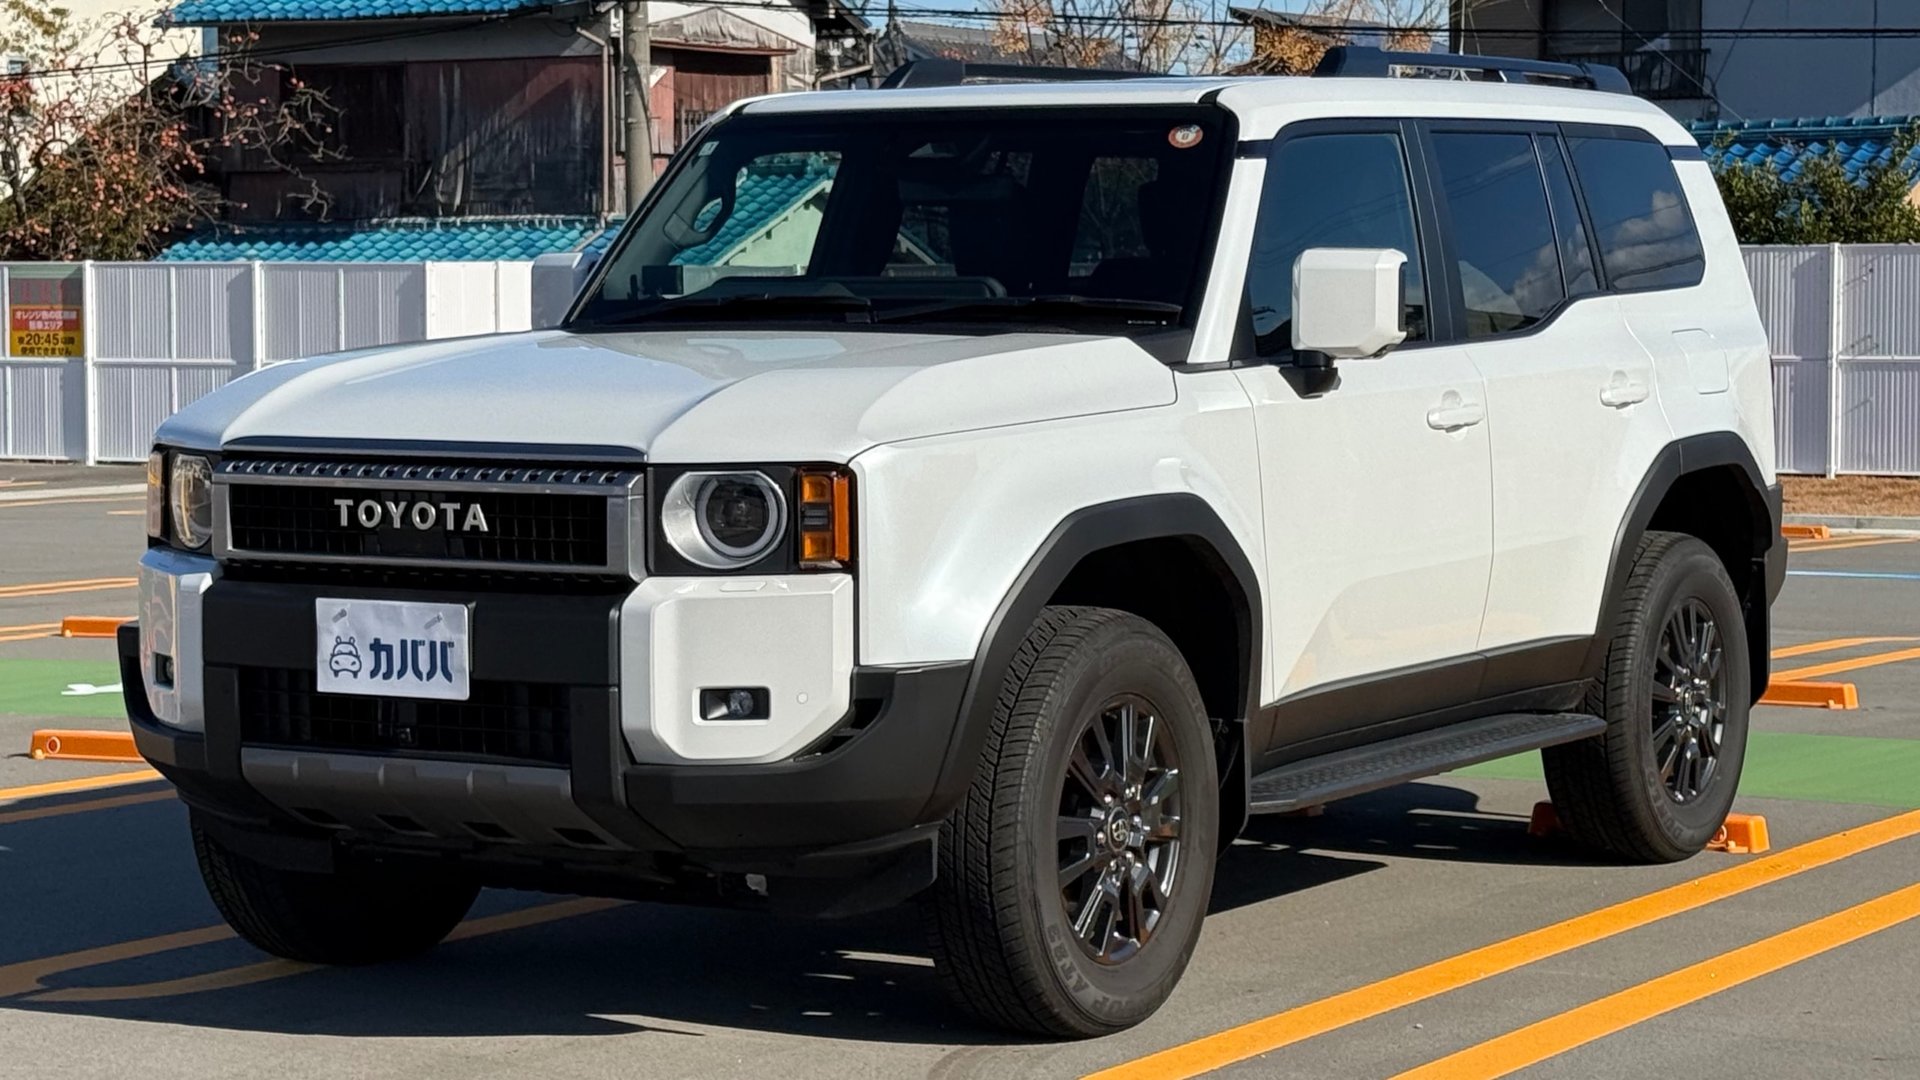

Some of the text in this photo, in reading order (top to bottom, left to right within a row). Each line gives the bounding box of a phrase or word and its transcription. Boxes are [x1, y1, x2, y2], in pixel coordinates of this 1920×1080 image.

[15, 310, 77, 320] オレンジ色の区
[334, 498, 489, 532] TOYOTA
[369, 637, 454, 683] カババ
